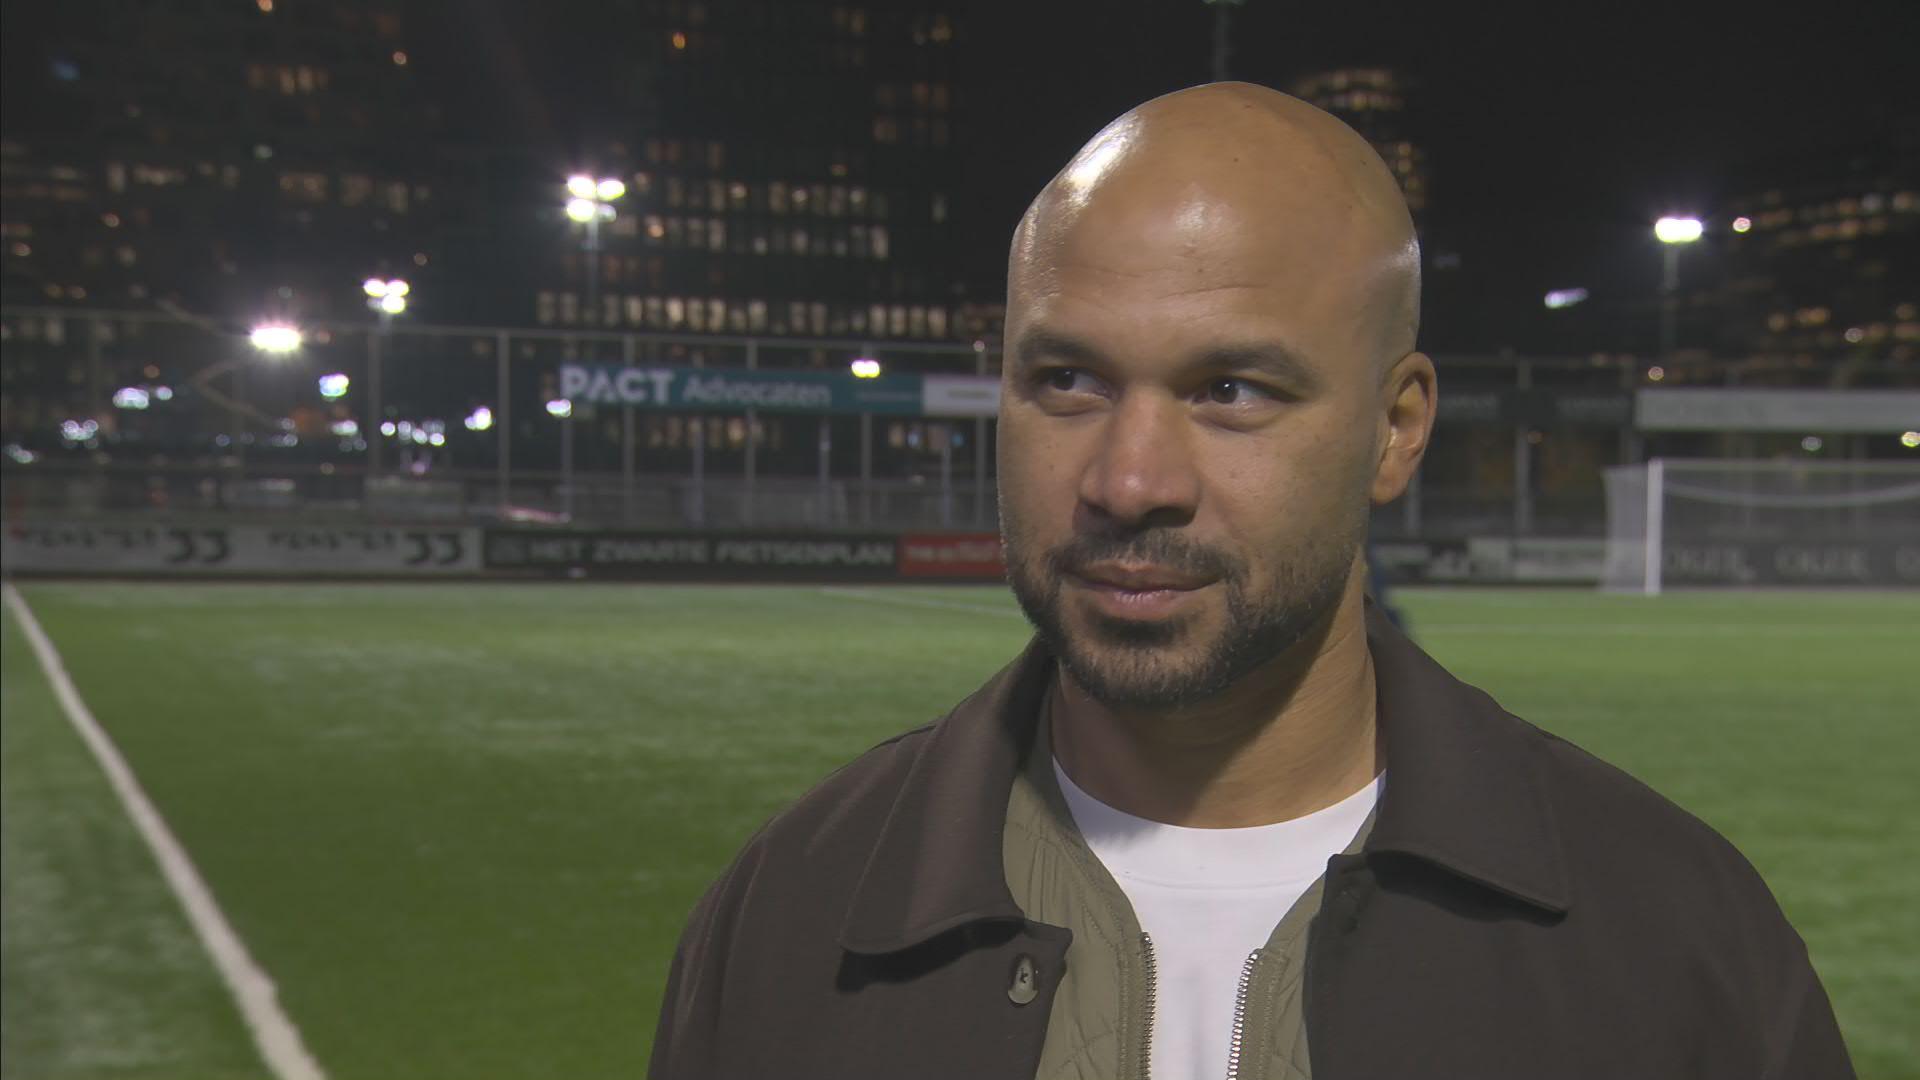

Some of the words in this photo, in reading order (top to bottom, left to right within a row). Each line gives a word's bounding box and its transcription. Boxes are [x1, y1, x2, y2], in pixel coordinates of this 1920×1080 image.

[561, 366, 674, 404] PACT
[682, 374, 832, 407] Advocaten
[530, 539, 584, 561] HET
[592, 540, 708, 562] ZWARTE
